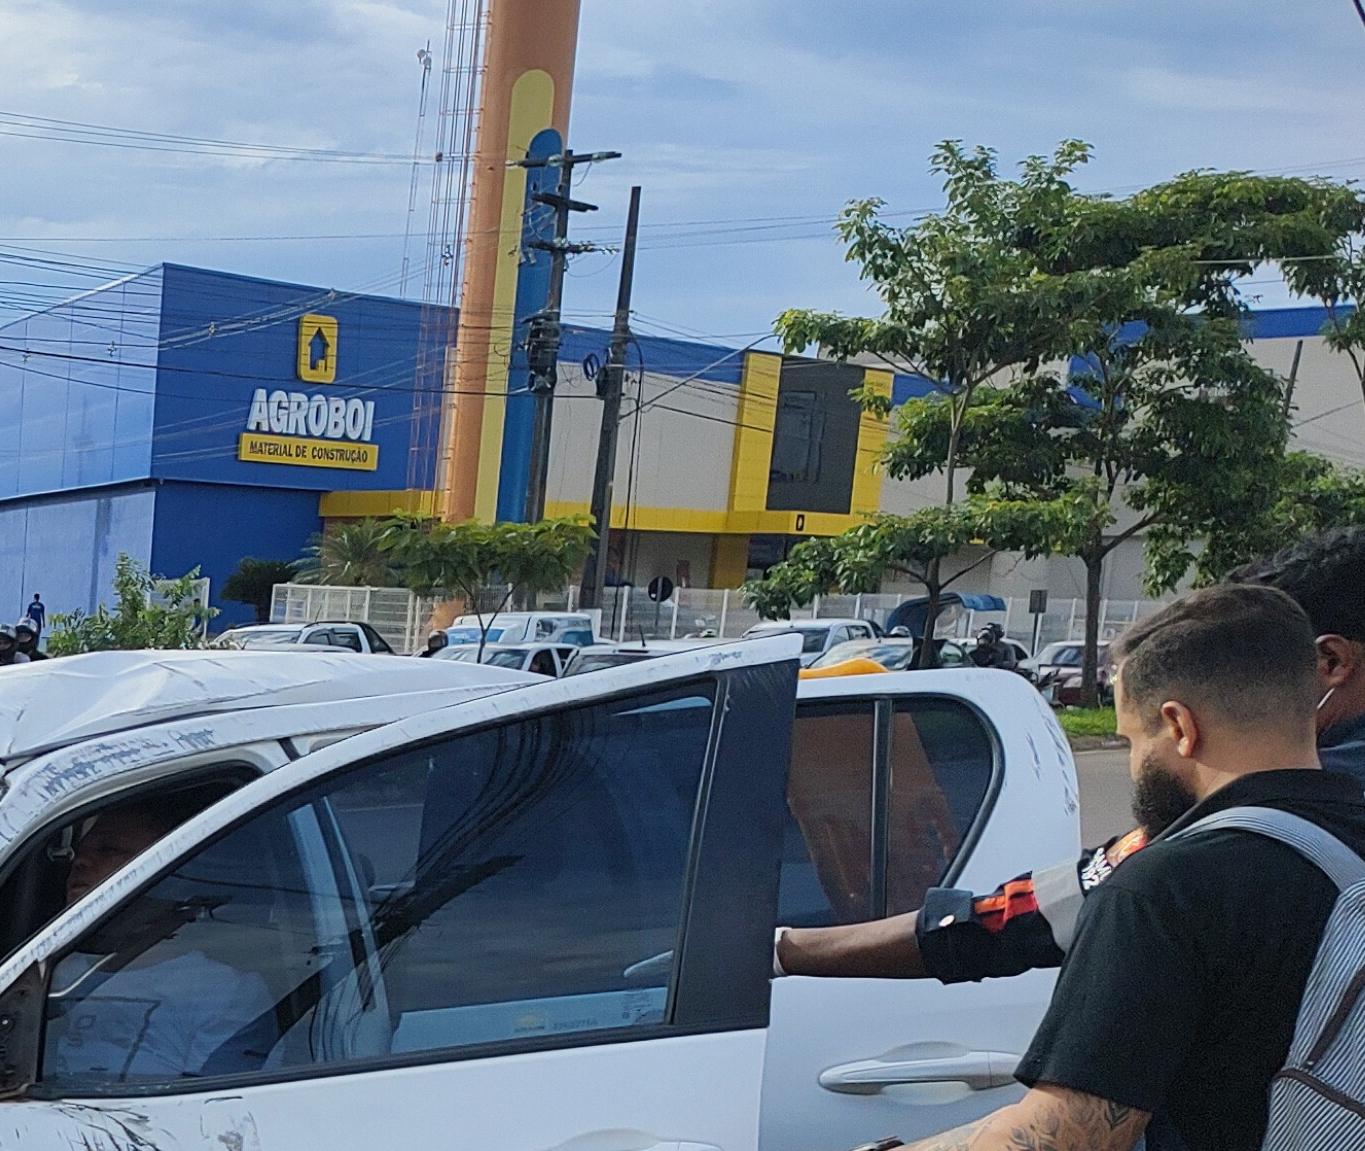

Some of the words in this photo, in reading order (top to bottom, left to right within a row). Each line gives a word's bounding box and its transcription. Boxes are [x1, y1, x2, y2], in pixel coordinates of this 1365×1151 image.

[246, 388, 375, 441] AGROBOI
[249, 440, 292, 457] MATERIAL
[295, 445, 307, 458] DE
[311, 446, 368, 464] CONSTRUÇÃO
